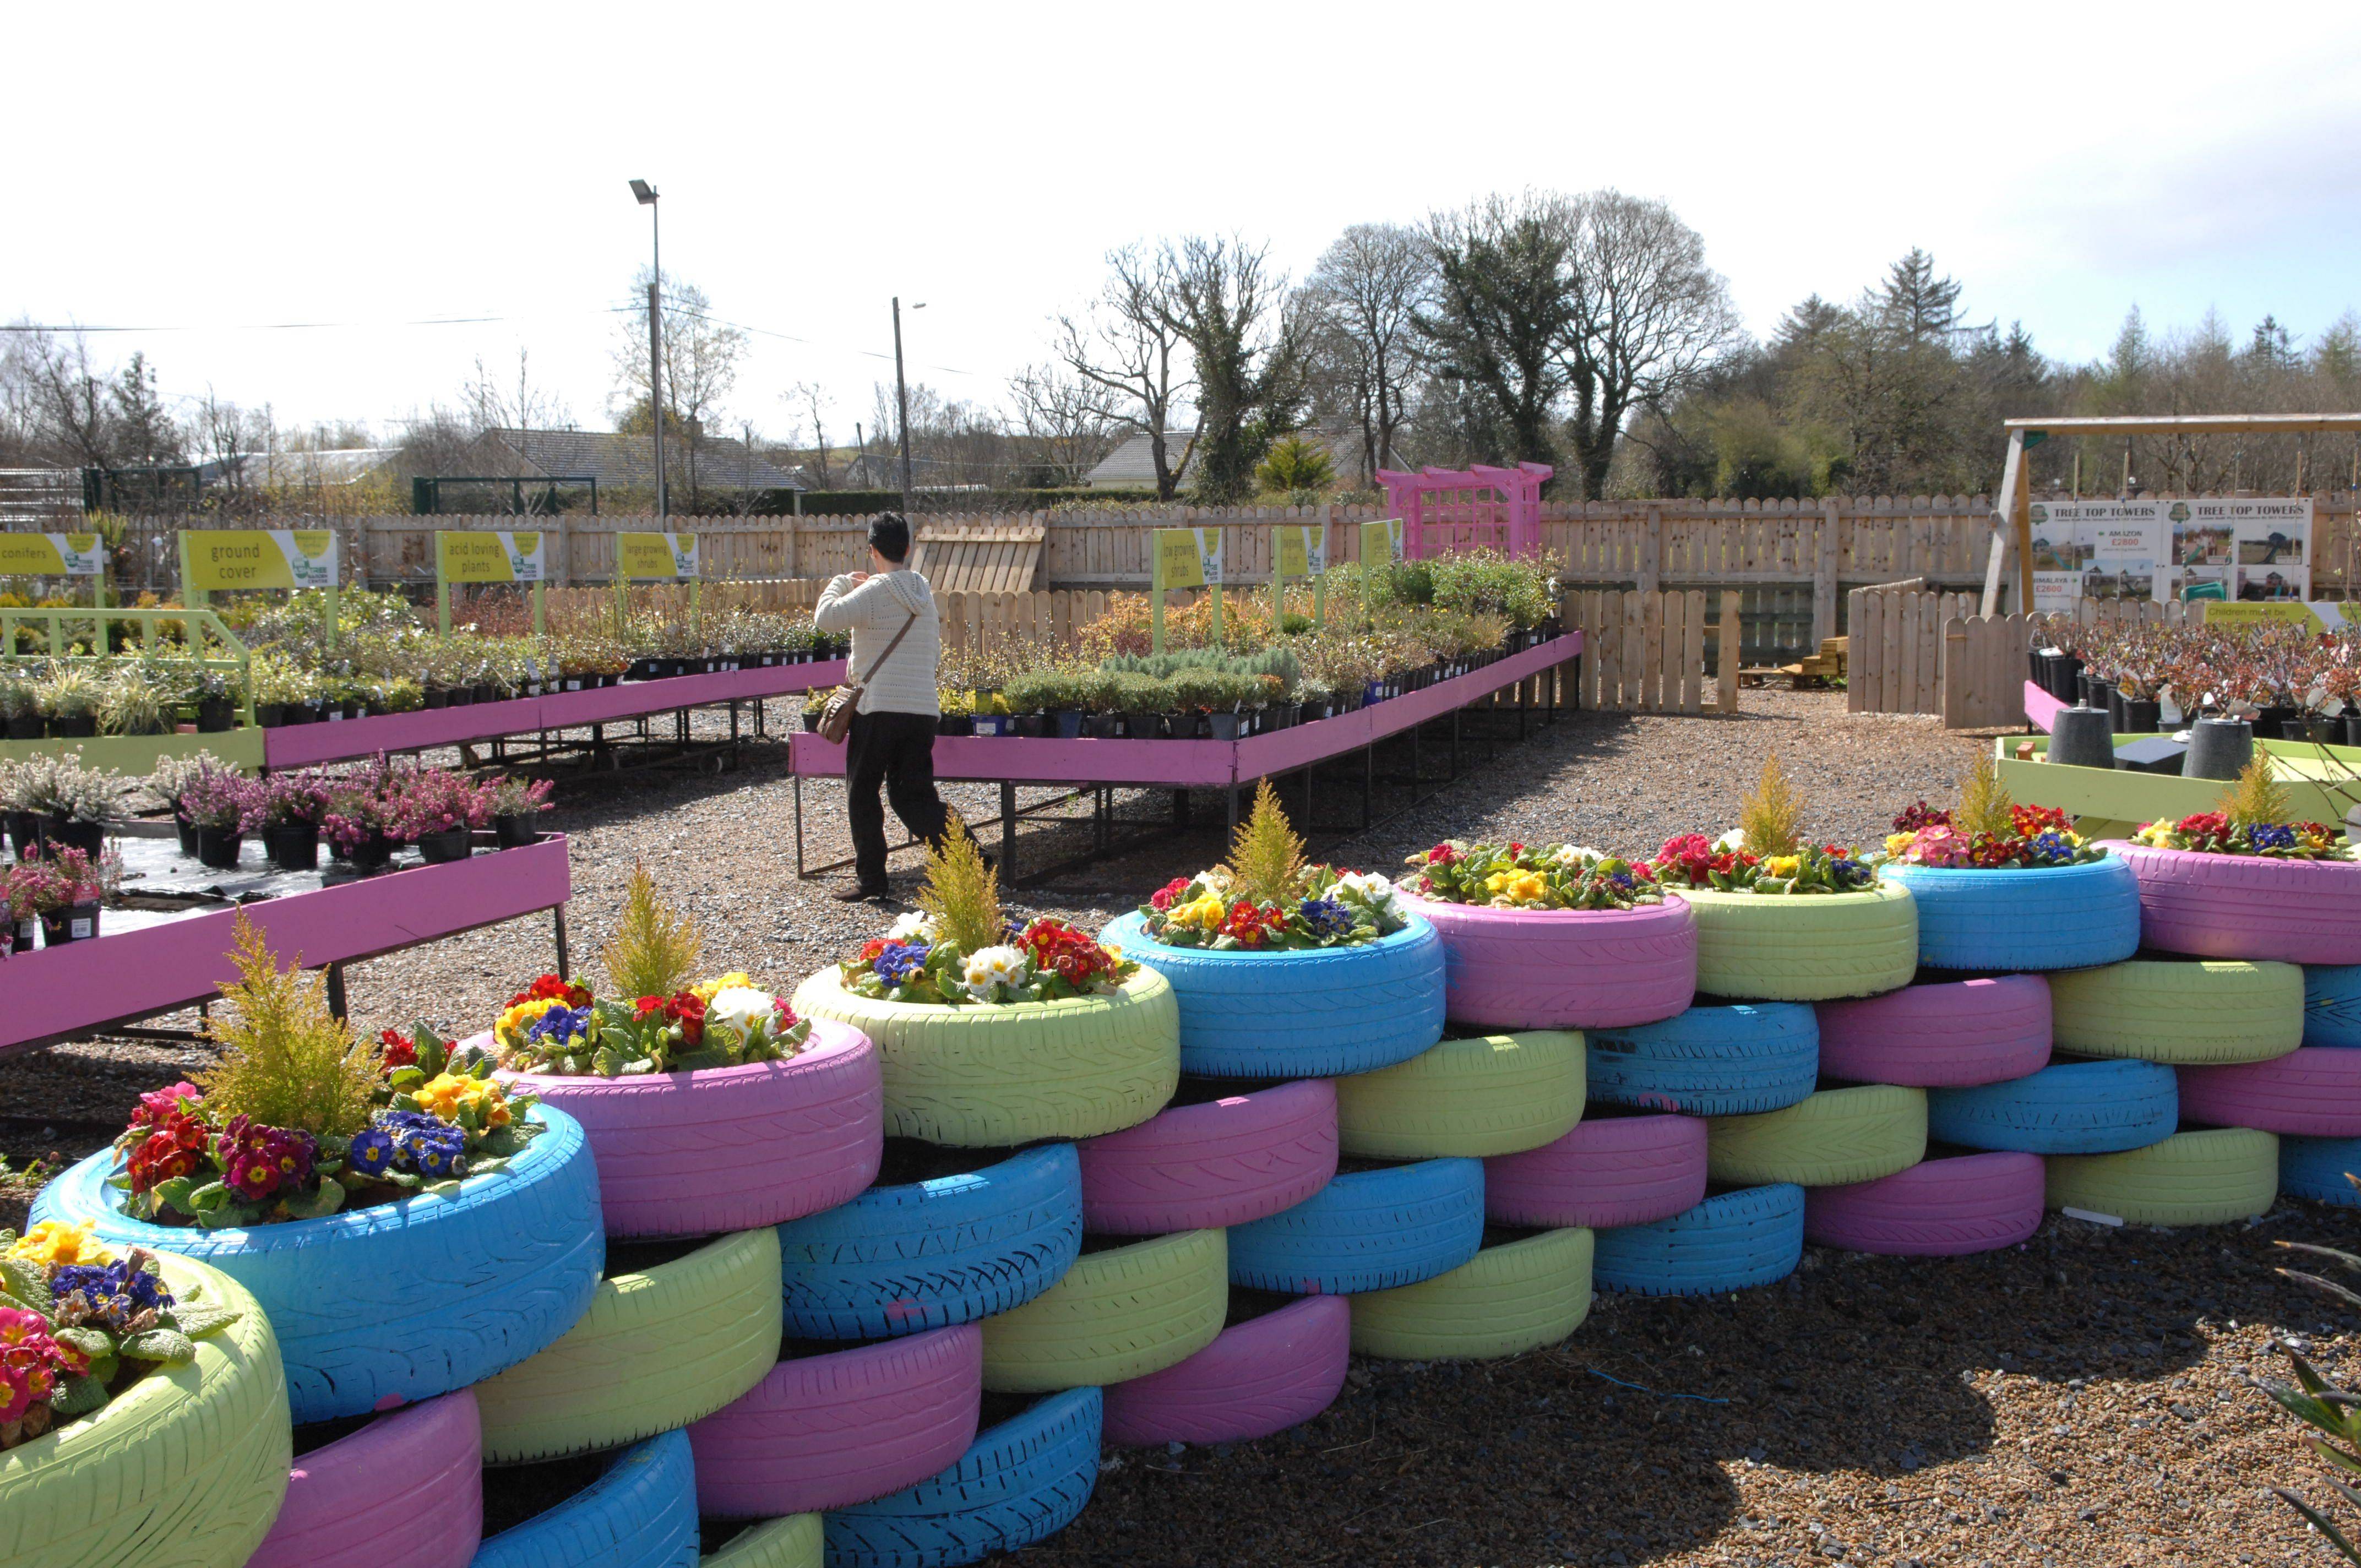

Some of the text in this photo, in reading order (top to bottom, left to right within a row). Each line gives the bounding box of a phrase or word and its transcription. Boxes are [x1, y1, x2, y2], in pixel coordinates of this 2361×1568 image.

[2054, 508, 2081, 518] TREE
[2085, 508, 2106, 517] TOP
[2110, 507, 2155, 517] TOWERS
[2197, 507, 2225, 515] TREE
[2229, 506, 2253, 515] TOP
[2256, 505, 2304, 515] TOWERS
[2112, 538, 2139, 546] £2800
[1, 547, 47, 559] conifers
[211, 543, 260, 562] ground
[449, 542, 468, 556] acid
[472, 542, 499, 558] loving
[625, 543, 641, 556] large
[643, 543, 667, 556] growing
[1163, 541, 1172, 558] low
[1174, 542, 1195, 560] growing
[462, 560, 490, 574] plants
[637, 559, 658, 569] shrubs
[1171, 562, 1189, 578] shrubs
[219, 567, 256, 579] cover
[2208, 607, 2246, 616] Children
[2275, 607, 2286, 616] be
